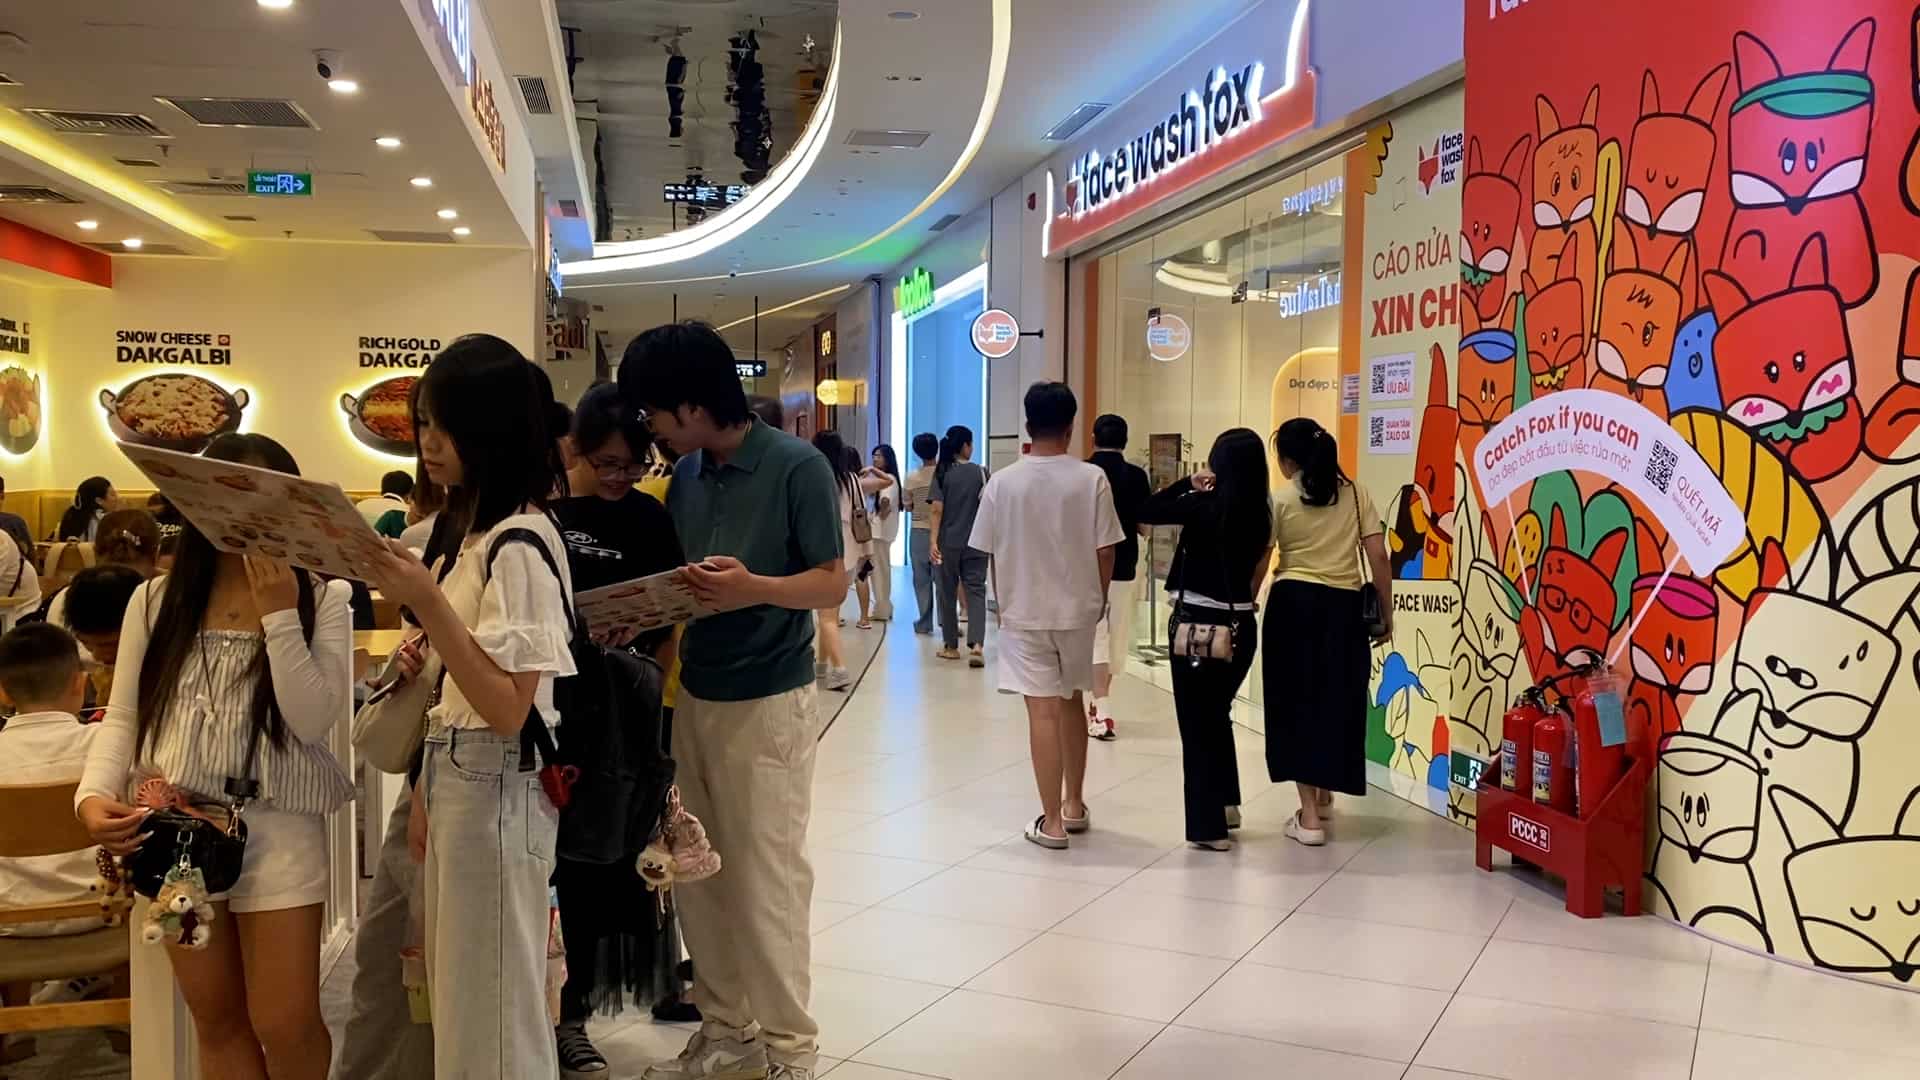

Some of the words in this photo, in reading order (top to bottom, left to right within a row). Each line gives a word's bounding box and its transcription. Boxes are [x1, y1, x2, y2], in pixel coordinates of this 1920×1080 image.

[1082, 149, 1127, 211] face
[1131, 92, 1197, 183] wash
[1203, 64, 1252, 145] fox
[1442, 133, 1463, 151] face
[1441, 168, 1456, 184] fox
[255, 184, 276, 193] EXIT
[1372, 240, 1411, 281] CÁO
[1416, 226, 1452, 272] RỬA
[1370, 292, 1414, 338] XIN
[1419, 283, 1460, 329] CH
[116, 331, 157, 344] SNOW
[160, 332, 212, 346] CHEESE
[359, 336, 396, 350] RICH
[398, 338, 441, 351] GOLD
[116, 346, 231, 366] DAKGALBI
[359, 352, 433, 369] DAKGA
[1289, 378, 1305, 389] Da
[1484, 425, 1527, 470] Catch
[1528, 413, 1556, 438] Fox
[1559, 405, 1570, 429] if
[1573, 411, 1604, 436] you
[1607, 419, 1639, 451] can
[1702, 508, 1723, 536] MÃ
[1393, 593, 1420, 612] FACE
[1454, 773, 1466, 785] EXIT
[1511, 816, 1538, 843] PCCC
